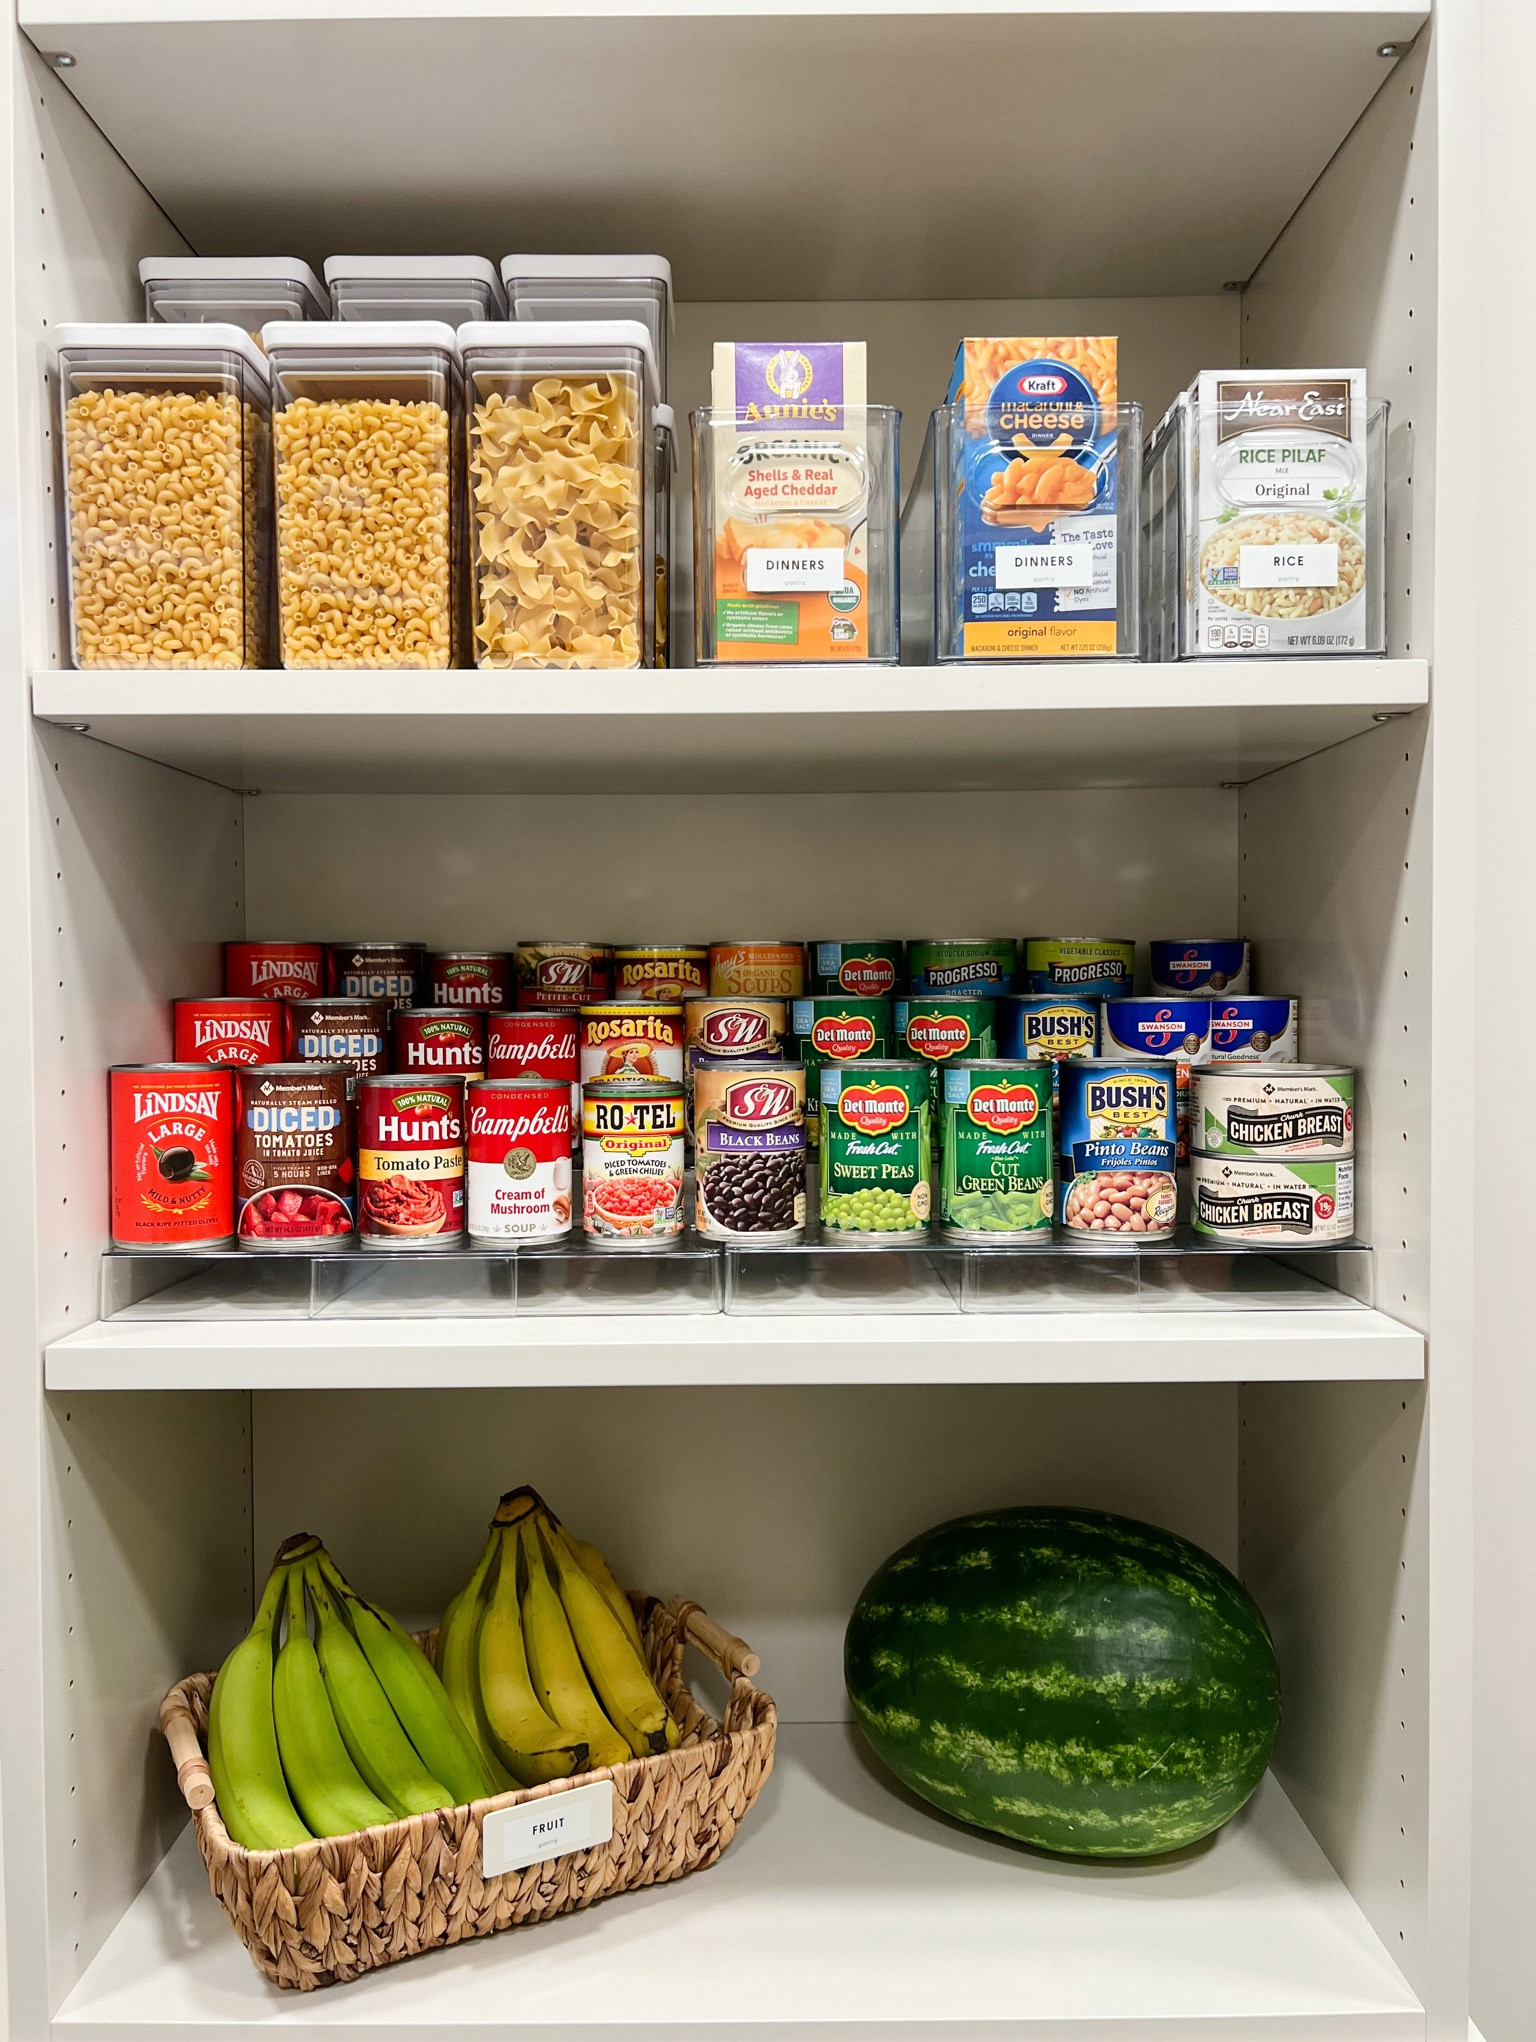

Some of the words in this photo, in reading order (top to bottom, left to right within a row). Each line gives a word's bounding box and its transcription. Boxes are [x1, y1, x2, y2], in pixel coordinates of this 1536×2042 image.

[1028, 381, 1056, 391] Kraft
[744, 397, 837, 423] Annie's
[1224, 391, 1297, 421] Near
[1298, 391, 1346, 421] East
[1240, 449, 1275, 463] RICE
[1282, 449, 1326, 463] PILAF
[748, 470, 788, 482] Shells
[791, 469, 801, 481] &
[805, 469, 834, 481] Real
[744, 485, 778, 499] Aged
[782, 484, 838, 496] Cheddar
[1255, 483, 1310, 499] Original
[1060, 533, 1081, 543] The
[1083, 529, 1114, 540] Taste
[766, 560, 825, 570] DINNERS
[1015, 556, 1074, 568] DINNERS
[1273, 556, 1304, 566] RICE
[972, 596, 986, 604] 250
[1008, 626, 1047, 639] original
[1050, 626, 1077, 636] flavor
[1210, 629, 1221, 638] 190
[1287, 636, 1299, 646] NET
[1300, 636, 1311, 646] WT
[1312, 636, 1325, 646] 6.09
[1326, 636, 1335, 645] OZ
[1336, 636, 1347, 646] (172
[1060, 947, 1093, 956] VEGETABLE
[1094, 948, 1121, 957] CLASSICS
[542, 959, 588, 985] S&W
[622, 958, 702, 986] Rosarita
[714, 951, 746, 981] Amy's
[1054, 962, 1122, 983] PROGRESSO
[843, 970, 861, 981] Del
[863, 969, 893, 981] Monte
[929, 962, 998, 986] PROGRESSO
[346, 975, 413, 997] DICED
[728, 969, 792, 994] SOUPS
[536, 992, 592, 1001] PETITE-CUT
[423, 1024, 440, 1035] 100%
[440, 1023, 470, 1035] NATURAL
[587, 1015, 674, 1046] Rosarita
[709, 1013, 764, 1043] S&W
[1027, 1015, 1094, 1040] BUSH'S
[1141, 1023, 1183, 1031] SWANSON
[816, 1029, 835, 1042] Del
[836, 1029, 872, 1042] Monte
[910, 1028, 927, 1041] Del
[928, 1028, 966, 1041] Monte
[303, 1034, 378, 1058] DICED
[488, 1033, 576, 1066] Campbell's
[700, 1043, 722, 1053] PREMIUM
[832, 1043, 856, 1053] Quality
[924, 1042, 949, 1051] Quality
[206, 1046, 259, 1064] LARGE
[397, 1095, 416, 1108] 100%
[416, 1095, 448, 1107] NATURAL
[734, 1083, 791, 1117] S&W
[843, 1098, 863, 1113] Del
[865, 1098, 905, 1113] Monte
[973, 1098, 994, 1113] Del
[996, 1098, 1035, 1113] Monte
[1091, 1086, 1166, 1112] BUSH'S
[253, 1106, 335, 1132] DICED
[471, 1104, 569, 1142] Campbell's
[722, 1116, 748, 1128] PREMIUM
[748, 1120, 773, 1128] QUALITY
[773, 1116, 788, 1125] SINCE
[860, 1115, 887, 1126] Quality
[991, 1115, 1018, 1126] Quality
[147, 1122, 206, 1144] LARGE
[830, 1132, 857, 1140] MADE
[891, 1131, 917, 1140] WITH
[958, 1131, 988, 1140] MADE
[1022, 1130, 1046, 1139] WITH
[1230, 1120, 1293, 1142] CHICKEN
[1297, 1115, 1342, 1135] BREAST
[254, 1133, 334, 1148] TOMATOES
[605, 1139, 668, 1151] Original
[719, 1133, 763, 1147] BLACK
[765, 1132, 800, 1146] BEANS
[272, 1149, 301, 1157] TOMATO
[303, 1148, 324, 1156] JUICE
[845, 1141, 875, 1155] Fresh
[976, 1140, 1007, 1155] Fresh
[1084, 1142, 1126, 1157] Pinto
[1129, 1142, 1169, 1157] Beans
[374, 1156, 431, 1171] Tomato
[433, 1155, 463, 1170] Paste
[604, 1159, 626, 1169] DICED
[627, 1158, 667, 1169] TOMATOES
[990, 1162, 1020, 1177] CUT
[1101, 1158, 1132, 1167] Frijoles
[1134, 1158, 1158, 1166] Pintos
[834, 1162, 879, 1180] SWEET
[880, 1164, 915, 1179] PEAS
[962, 1175, 1005, 1191] GREEN
[1007, 1175, 1044, 1191] BEANS
[1201, 1177, 1225, 1186] PREMIUM
[148, 1188, 168, 1204] MILD
[179, 1185, 207, 1204] NUTTY
[495, 1189, 532, 1200] Cream
[534, 1188, 546, 1199] of
[490, 1203, 550, 1215] Mushroom
[1200, 1200, 1249, 1224] CHICKEN
[1253, 1202, 1310, 1222] BREAST
[504, 1224, 537, 1233] SOUP
[532, 1817, 565, 1836] FRUIT
